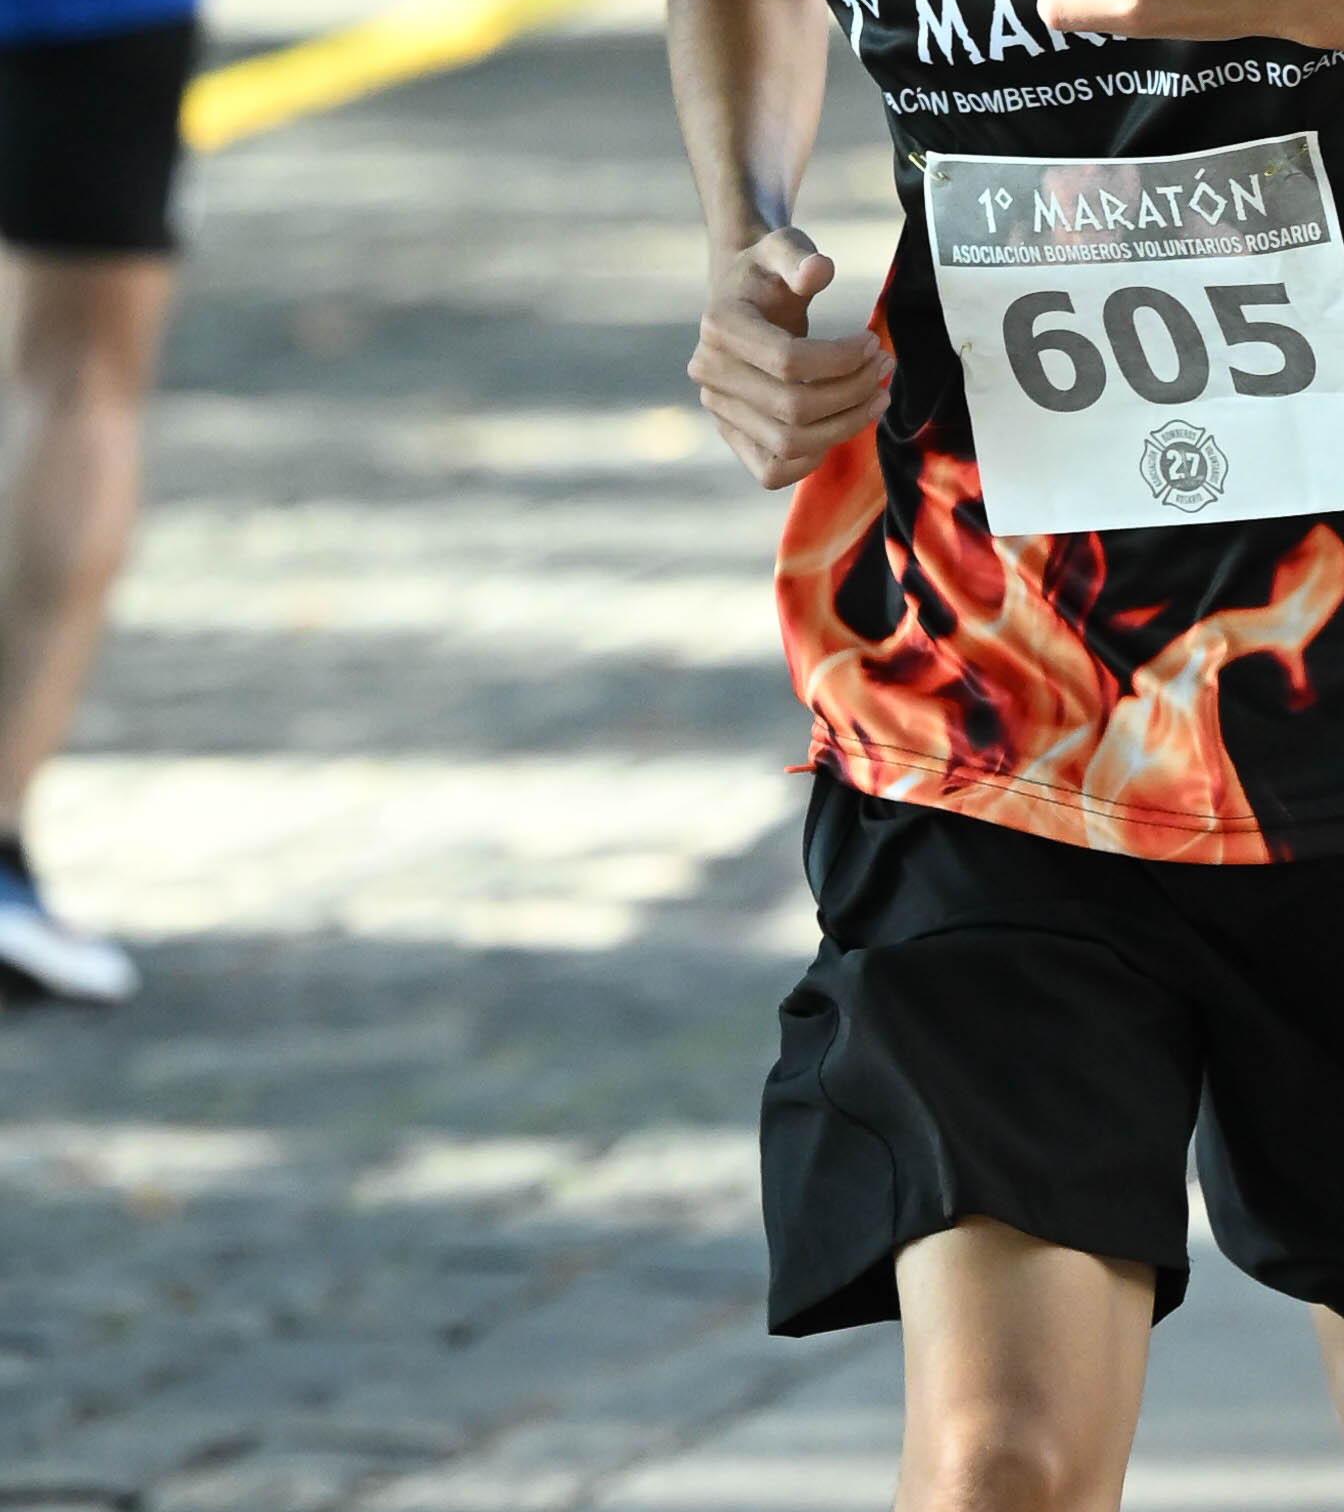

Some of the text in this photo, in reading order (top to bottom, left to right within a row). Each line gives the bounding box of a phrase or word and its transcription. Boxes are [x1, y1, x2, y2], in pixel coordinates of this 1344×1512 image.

[953, 78, 1093, 113] BOMBEROS
[1096, 59, 1262, 98] VOLUNTARIOS
[1033, 168, 1268, 233] MARATÓN
[952, 221, 1322, 265] ASOCIACIÓN BOMBEROS VOLUNTARIOS ROSARIO
[1001, 281, 1317, 413] 605
[1165, 448, 1200, 481] 27
